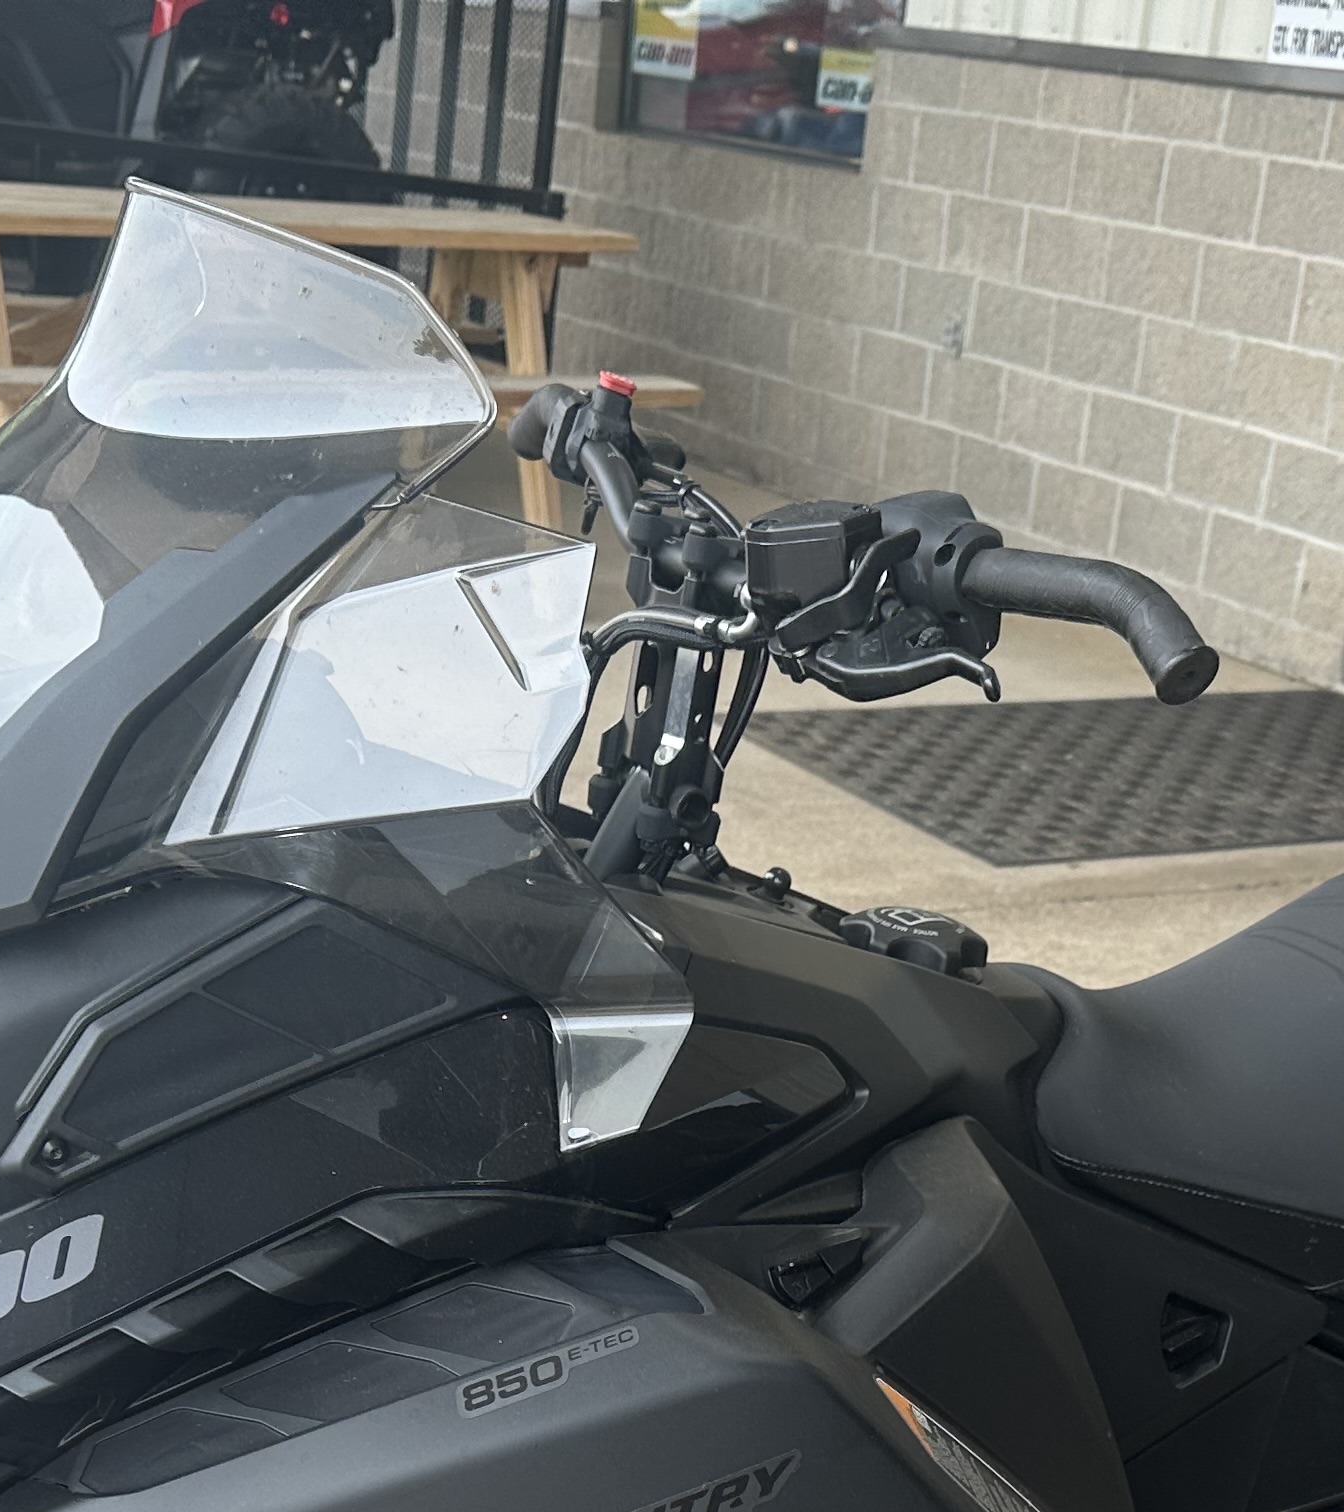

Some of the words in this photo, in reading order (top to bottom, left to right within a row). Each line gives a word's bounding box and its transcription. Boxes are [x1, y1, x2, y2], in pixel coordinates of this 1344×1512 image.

[823, 78, 873, 104] can-a
[462, 1355, 564, 1413] 850
[568, 1328, 635, 1362] E-TEC
